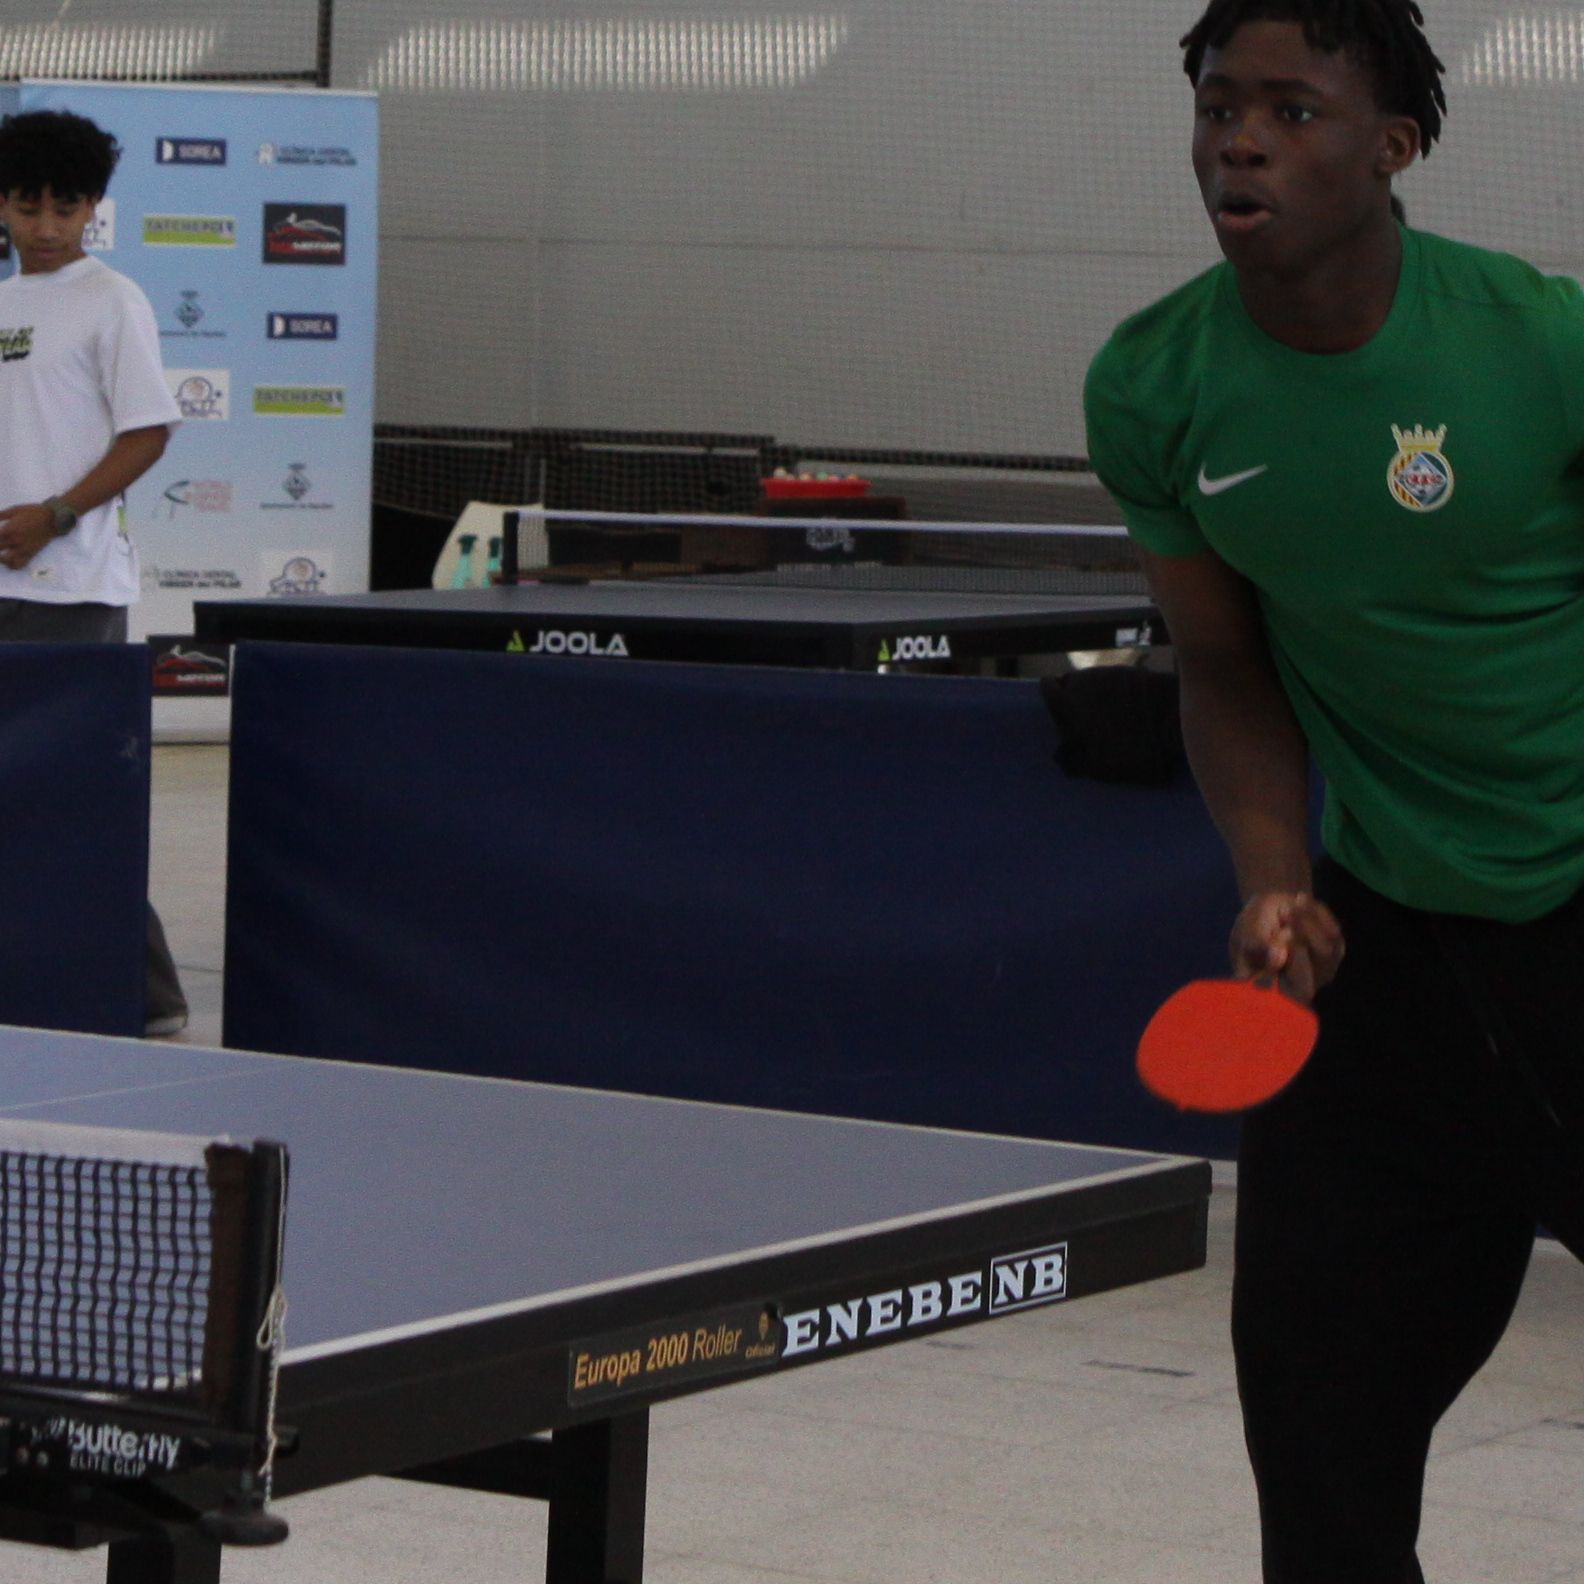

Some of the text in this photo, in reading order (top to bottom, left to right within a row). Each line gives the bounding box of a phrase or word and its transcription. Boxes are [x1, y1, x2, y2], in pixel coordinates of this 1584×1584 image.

[529, 630, 629, 656] JOOLA
[892, 635, 951, 660] JOOLA
[781, 1252, 1065, 1357] ENEBE NB
[574, 1324, 743, 1389] Europa 2000 Roller
